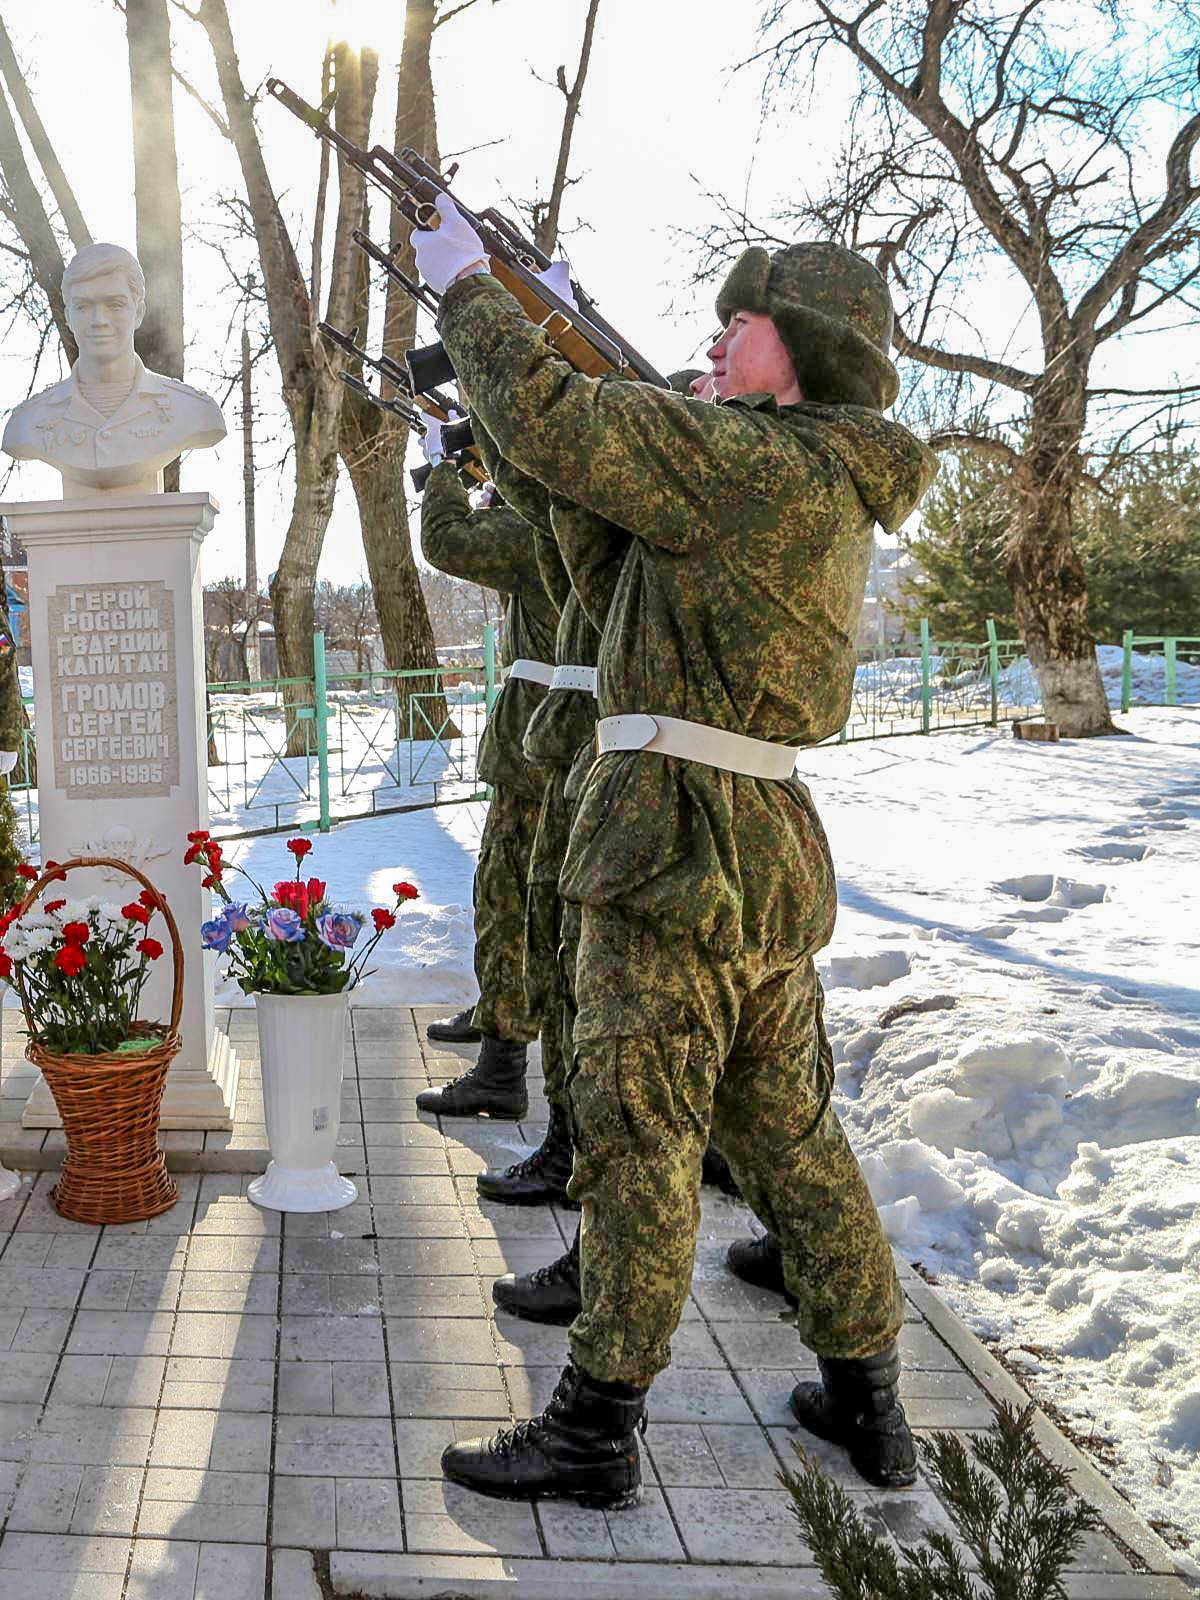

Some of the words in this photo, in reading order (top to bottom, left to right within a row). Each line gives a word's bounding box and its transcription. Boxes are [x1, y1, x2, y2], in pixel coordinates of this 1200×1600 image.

[70, 586, 149, 611] ГЕРОЙ
[63, 608, 159, 633] РОССИИ
[56, 631, 168, 656] ГВАРДИИ
[57, 652, 169, 677] КАПИТАН
[60, 681, 166, 712] ГРОМОВ
[67, 709, 162, 737] СЕРГЕЙ
[61, 735, 169, 762] СЕРГЕЕВИЧ
[70, 764, 163, 785] 1966-1995
